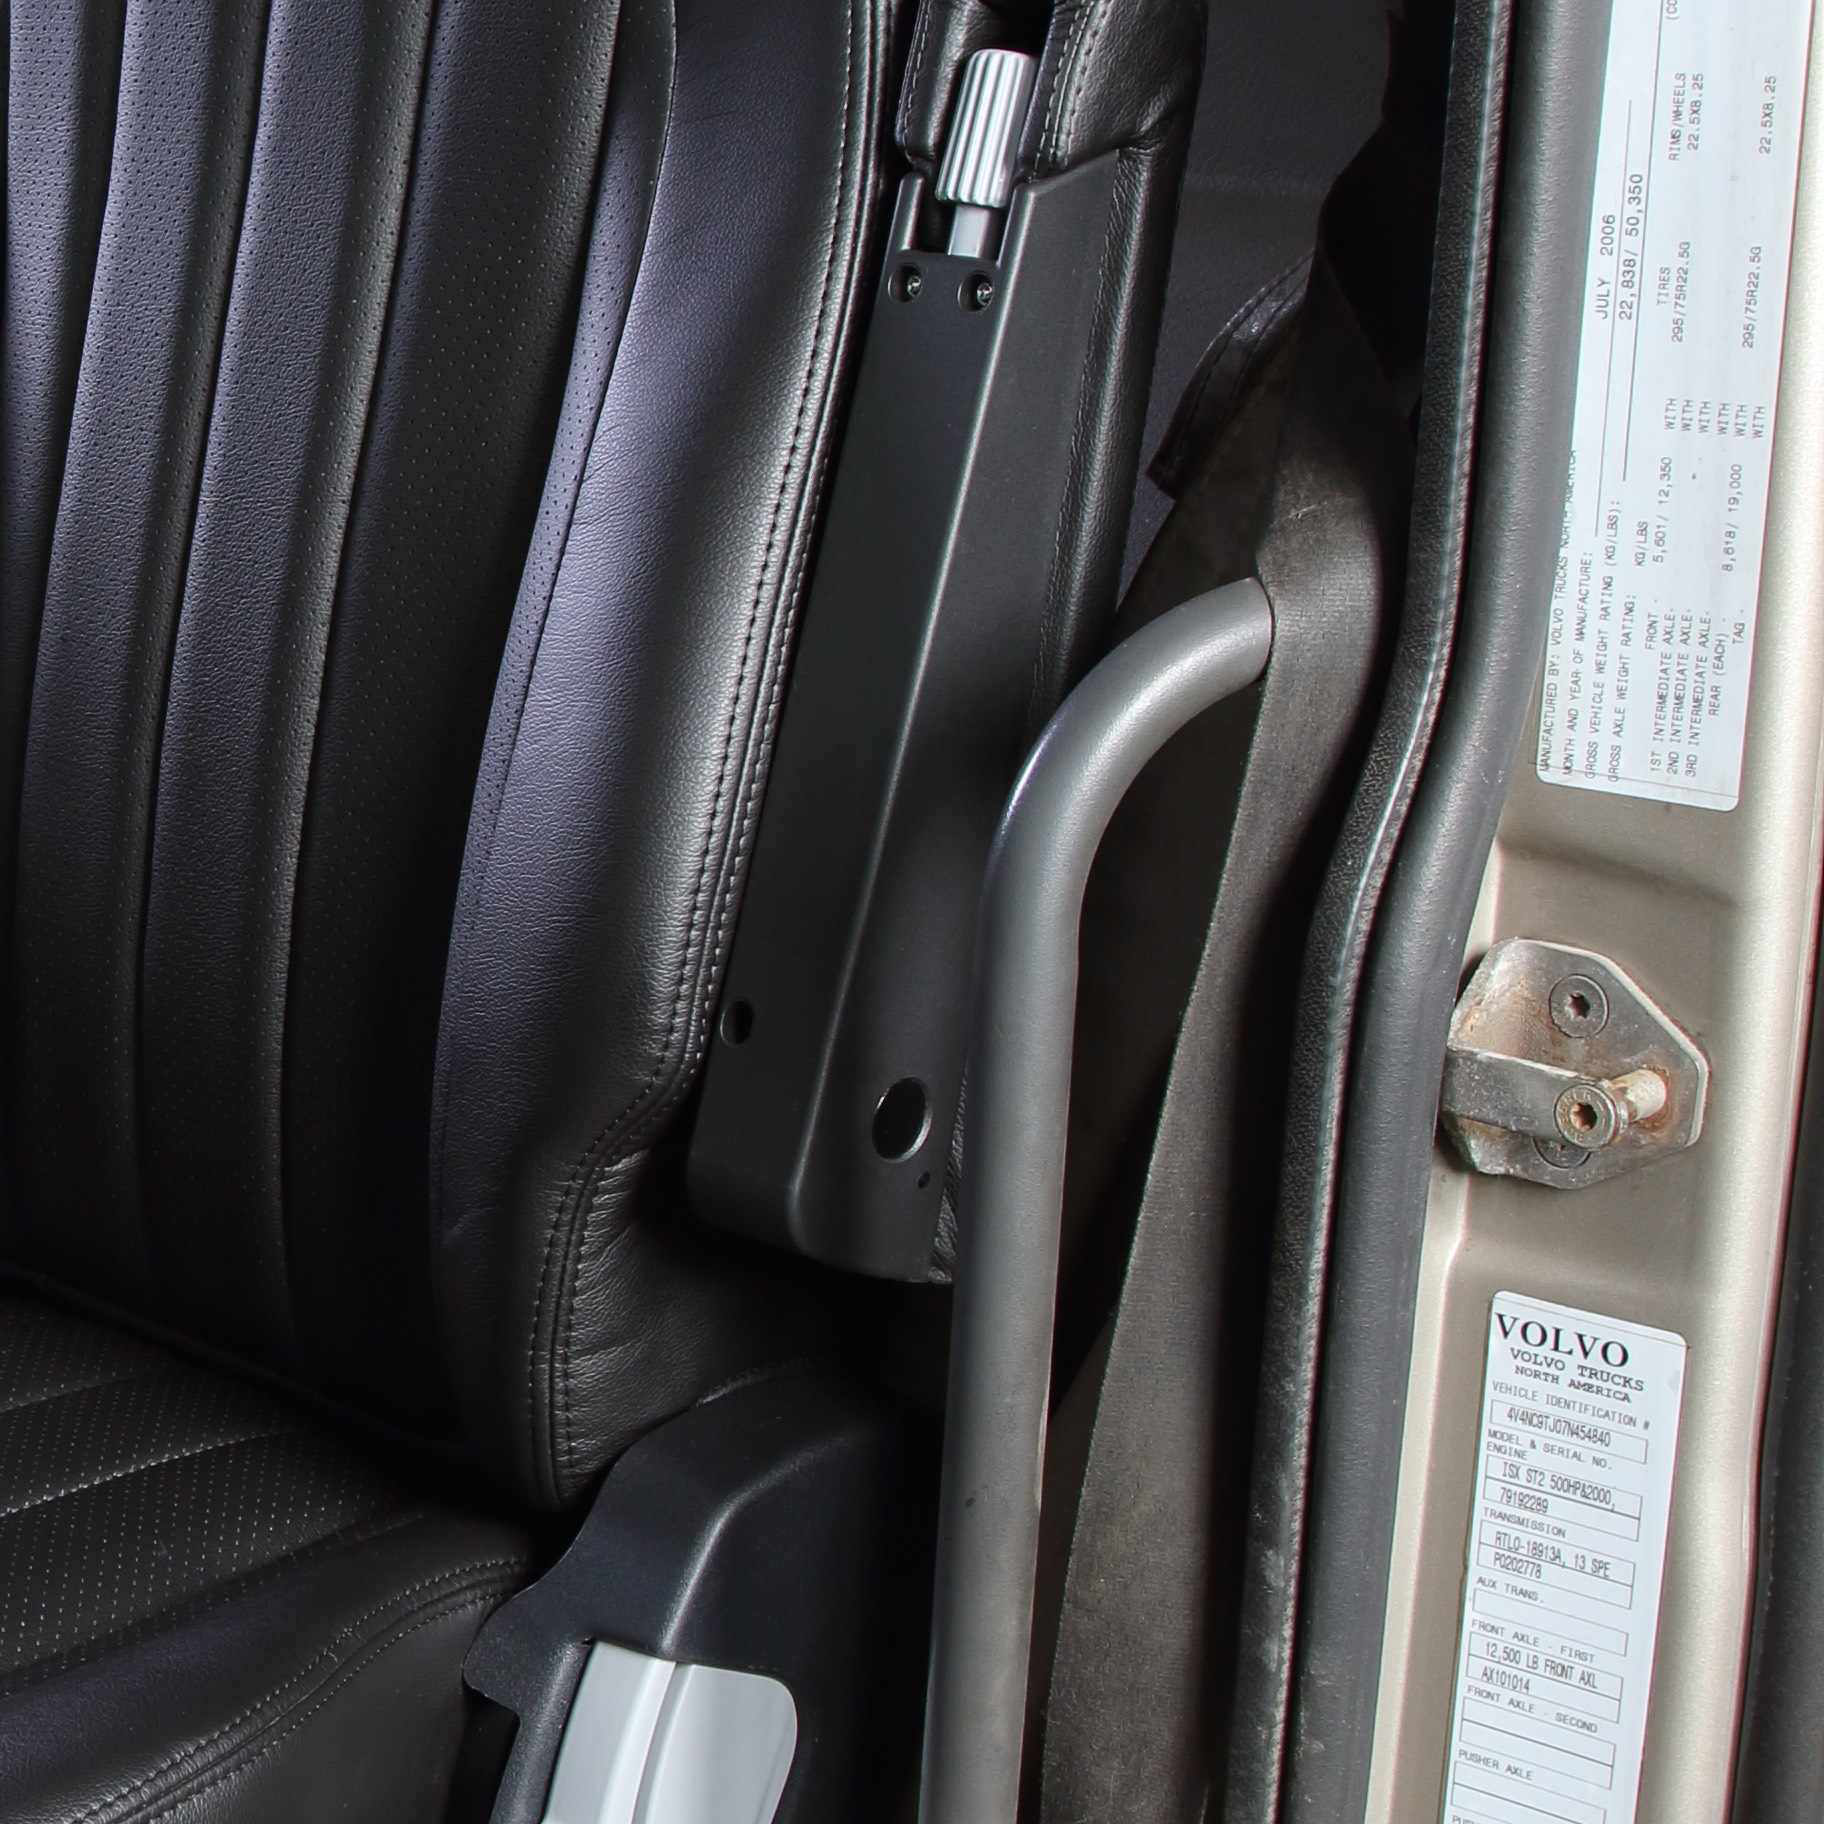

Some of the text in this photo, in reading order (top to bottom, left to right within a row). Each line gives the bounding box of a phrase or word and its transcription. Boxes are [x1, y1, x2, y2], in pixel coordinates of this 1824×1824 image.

[1686, 73, 1703, 150] 22.5X8.25
[1758, 75, 1776, 154] 22.5X8.25
[1599, 214, 1615, 256] 2006
[1594, 277, 1610, 320] JULY
[1634, 72, 1686, 566] KG/LBS TIRES RIMS/WHEELS
[1663, 397, 1676, 429] WITH
[1680, 399, 1693, 431] WITH
[1697, 400, 1710, 433] WITH
[1717, 402, 1730, 435] WITH
[1733, 404, 1747, 437] WITH
[1583, 173, 1643, 779] GROSS VEHICLE WEIGHT RATING (KG/LBS): 22,838/ 50,350
[1657, 456, 1672, 504] 12,350
[1727, 463, 1743, 512] 19,000
[1731, 405, 1764, 644] TAG WITH
[1574, 552, 1592, 641] MANUFACTURE:
[1551, 607, 1564, 645] VOLVO
[1644, 612, 1658, 649] FRONT
[1548, 654, 1560, 676] BY:
[1572, 648, 1583, 664] OF
[1712, 633, 1728, 676] (EACH)
[1607, 594, 1636, 782] GROSS AXLE WEIGHT RATING:
[1652, 651, 1671, 741] INTERMEDIATE
[1669, 652, 1688, 743] INTERMEDIATE
[1687, 655, 1707, 746] INTERMEDIATE
[1707, 684, 1721, 716] REAR
[1540, 682, 1557, 771] MANUFACTURED
[1566, 707, 1578, 732] AND
[1649, 750, 1661, 771] 1ST
[1666, 751, 1679, 774] 2ND
[1684, 753, 1697, 777] 3RD
[1496, 1312, 1629, 1367] VOLVO
[1509, 1346, 1644, 1391] VOLVO TRUCKS
[1514, 1364, 1631, 1403] NORTH AMERICA
[1492, 1380, 1538, 1401] VEHICLE
[1545, 1393, 1637, 1427] IDENTIFICATION
[1505, 1404, 1611, 1449] 4V4NC9TJ07N454840
[1486, 1440, 1528, 1460] ENGINE
[1487, 1428, 1612, 1469] MODEL & SERIAL NO.
[1501, 1460, 1521, 1483] ISX
[1524, 1466, 1545, 1490] ST2
[1497, 1485, 1549, 1514] 79192289
[1483, 1506, 1566, 1538] TRANSMISSION
[1569, 1550, 1587, 1572] 13
[1587, 1555, 1611, 1578] SPE
[1476, 1575, 1543, 1603] AUX TRANS.
[1471, 1618, 1595, 1663] FRONT AXLE FIRST
[1480, 1664, 1530, 1694] AX101014
[1525, 1651, 1539, 1673] LB
[1543, 1657, 1575, 1683] FRONT
[1578, 1667, 1599, 1690] AXL
[1467, 1684, 1597, 1733] FRONT AXLE SECOND
[1458, 1748, 1532, 1780] PUSHER AXLE
